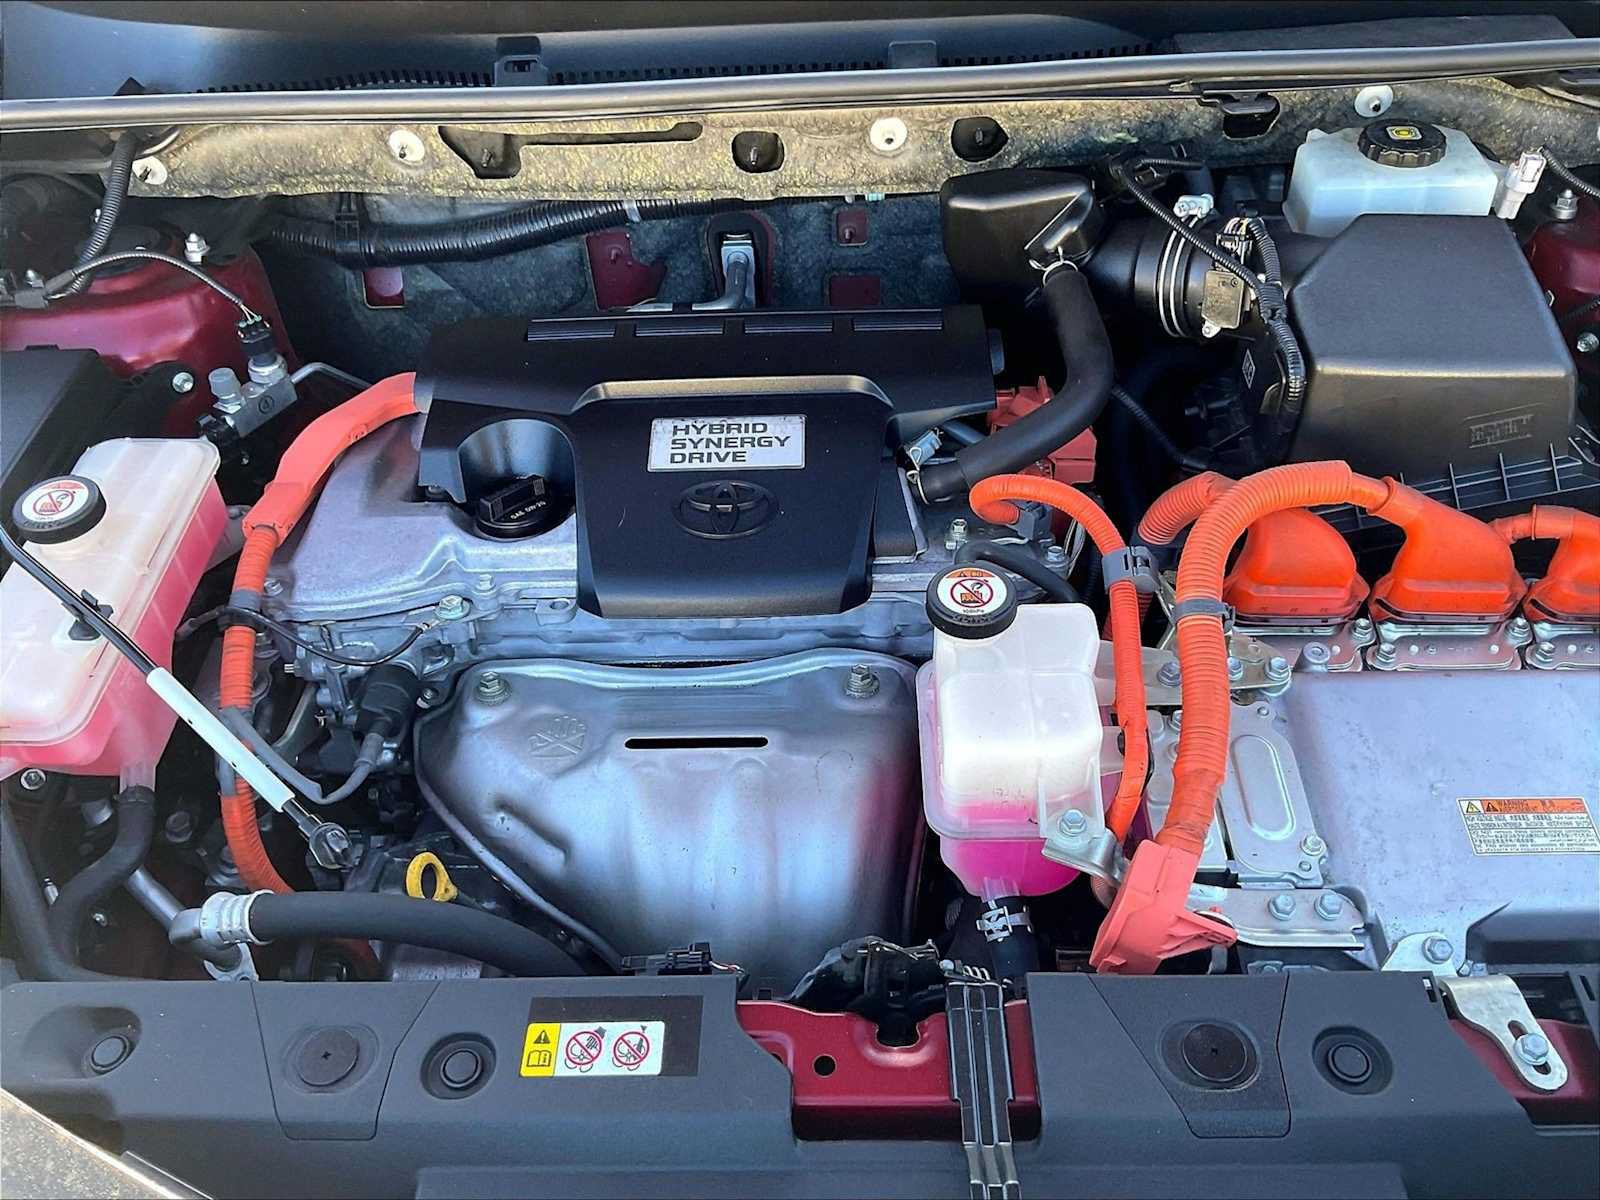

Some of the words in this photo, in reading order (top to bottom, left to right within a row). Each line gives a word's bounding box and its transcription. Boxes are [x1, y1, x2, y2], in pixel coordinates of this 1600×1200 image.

[672, 423, 768, 436] HYBRID
[671, 436, 791, 450] SYNERGY
[670, 451, 746, 464] DRIVE
